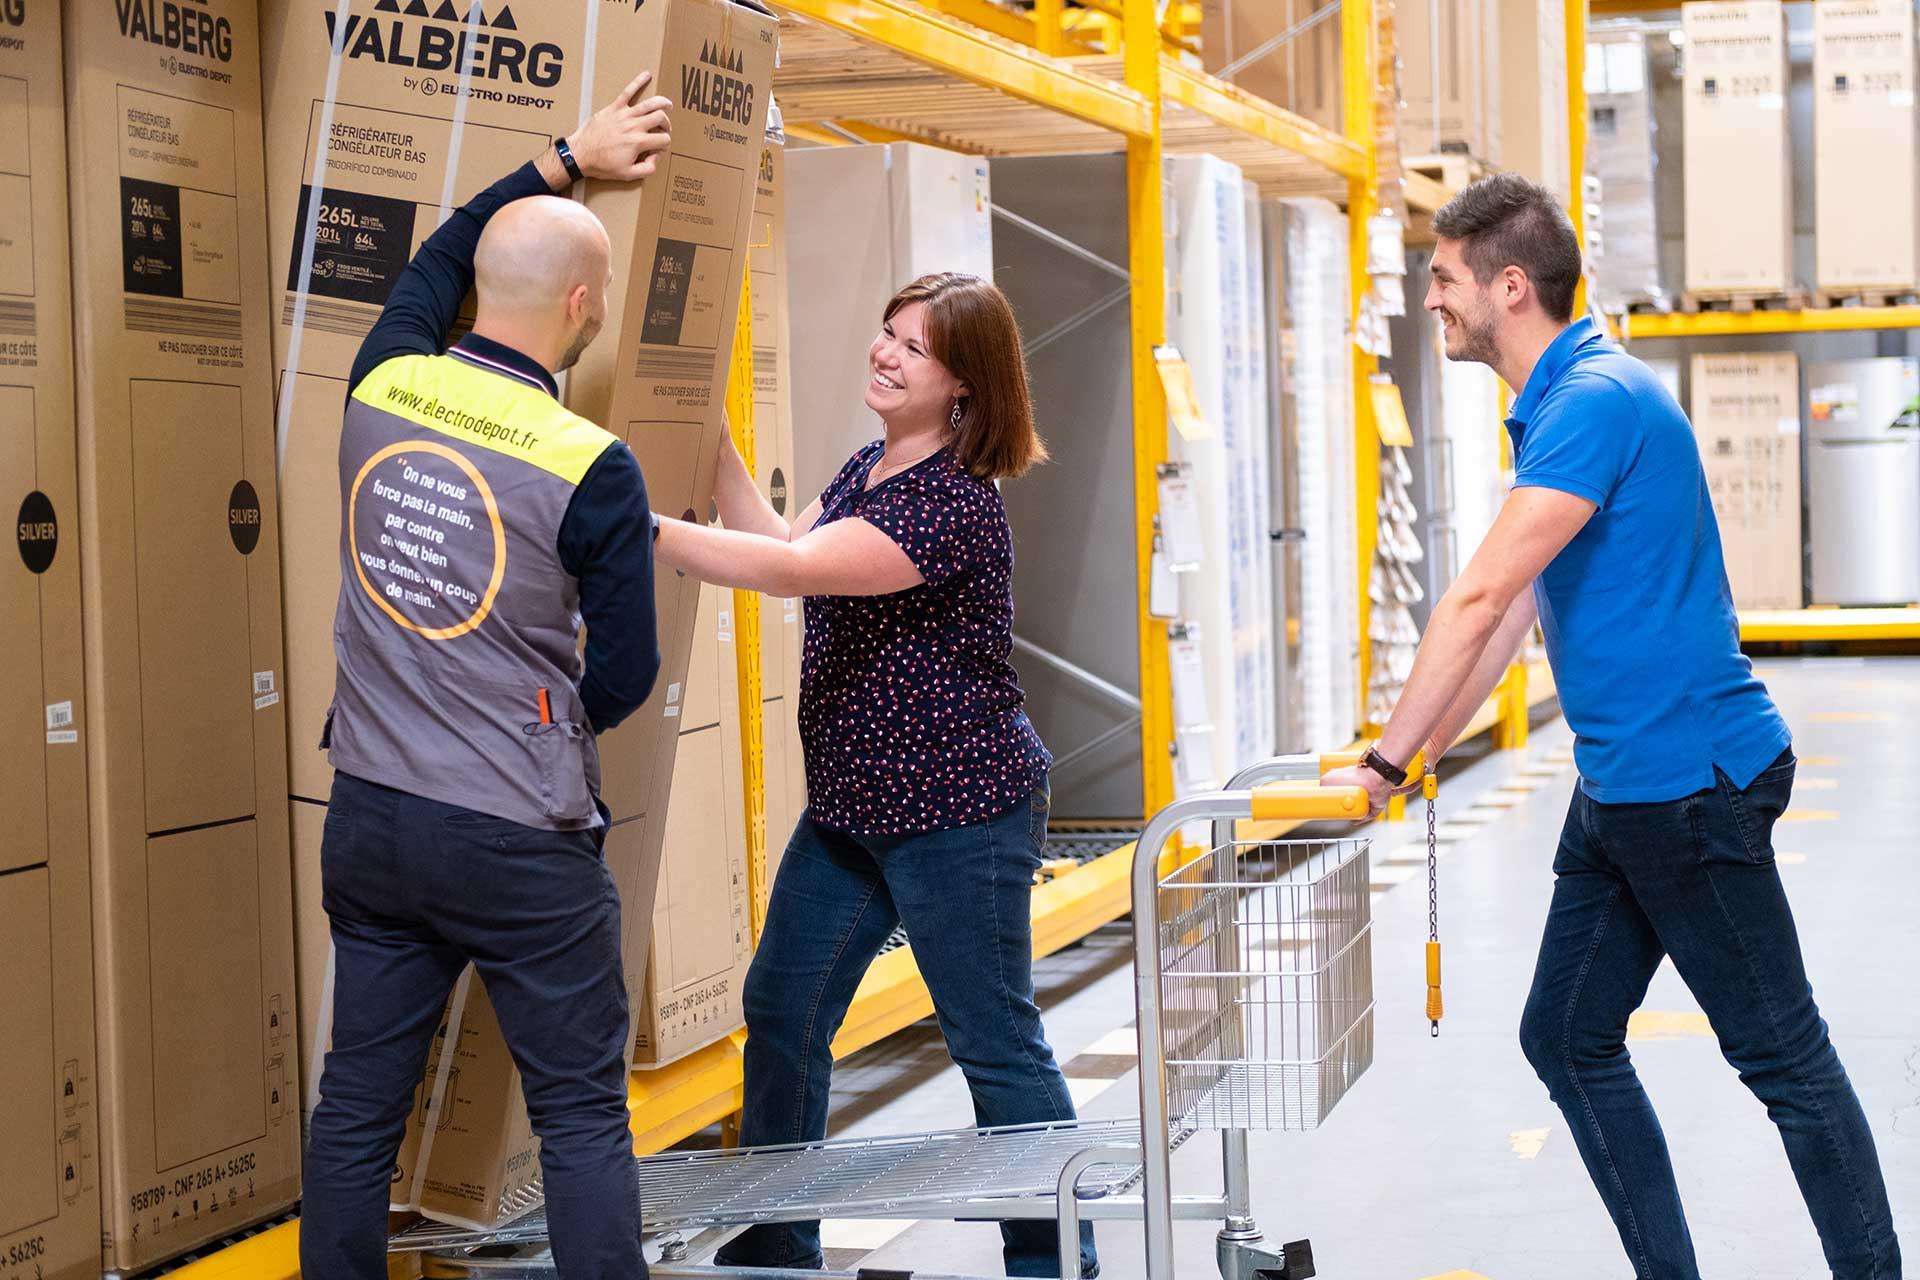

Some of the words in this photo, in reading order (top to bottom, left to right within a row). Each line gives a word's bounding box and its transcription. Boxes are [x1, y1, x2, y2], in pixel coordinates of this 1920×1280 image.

[114, 0, 233, 63] VALBERG
[323, 10, 565, 89] VALBERG
[178, 61, 209, 79] ELECTRO
[209, 70, 232, 84] DEPOT
[403, 76, 419, 91] by
[506, 93, 555, 110] DEPOT
[681, 63, 754, 126] VALBERG
[330, 122, 414, 147] RÉFRIGÉRATEUR
[715, 129, 734, 143] ELECTRO
[328, 138, 402, 160] CONGÉLATEUR
[404, 149, 427, 164] BAS
[371, 166, 418, 181] COMBINADO
[131, 196, 153, 218] 265L
[318, 205, 360, 228] 265L
[315, 226, 341, 240] 201L
[354, 232, 375, 246] 64L
[158, 341, 168, 353] NE
[168, 341, 180, 354] PAS
[181, 342, 208, 356] COUCHER
[208, 345, 220, 356] SUR
[221, 346, 229, 358] CE
[229, 344, 243, 359] CÔTÉ
[387, 385, 540, 450] www.electrodepot.fr
[419, 473, 436, 490] ne
[437, 480, 468, 501] vous
[230, 509, 260, 526] SILVER
[372, 479, 402, 503] force
[401, 493, 424, 512] pas
[423, 502, 436, 516] la
[437, 507, 475, 531] main,
[19, 523, 56, 541] SILVER
[384, 513, 407, 529] par
[407, 520, 445, 544] contre
[380, 533, 395, 548] on
[394, 539, 419, 559] veut
[421, 545, 448, 568] bien
[360, 551, 387, 571] vous
[445, 583, 478, 605] coup
[386, 582, 402, 598] de
[405, 589, 436, 609] main.
[131, 1184, 166, 1214] 958789
[174, 1174, 194, 1197] CNF
[196, 1168, 213, 1190] 265
[215, 1164, 226, 1184] A+
[227, 1152, 256, 1178] S625C
[9, 1236, 45, 1266] S625C
